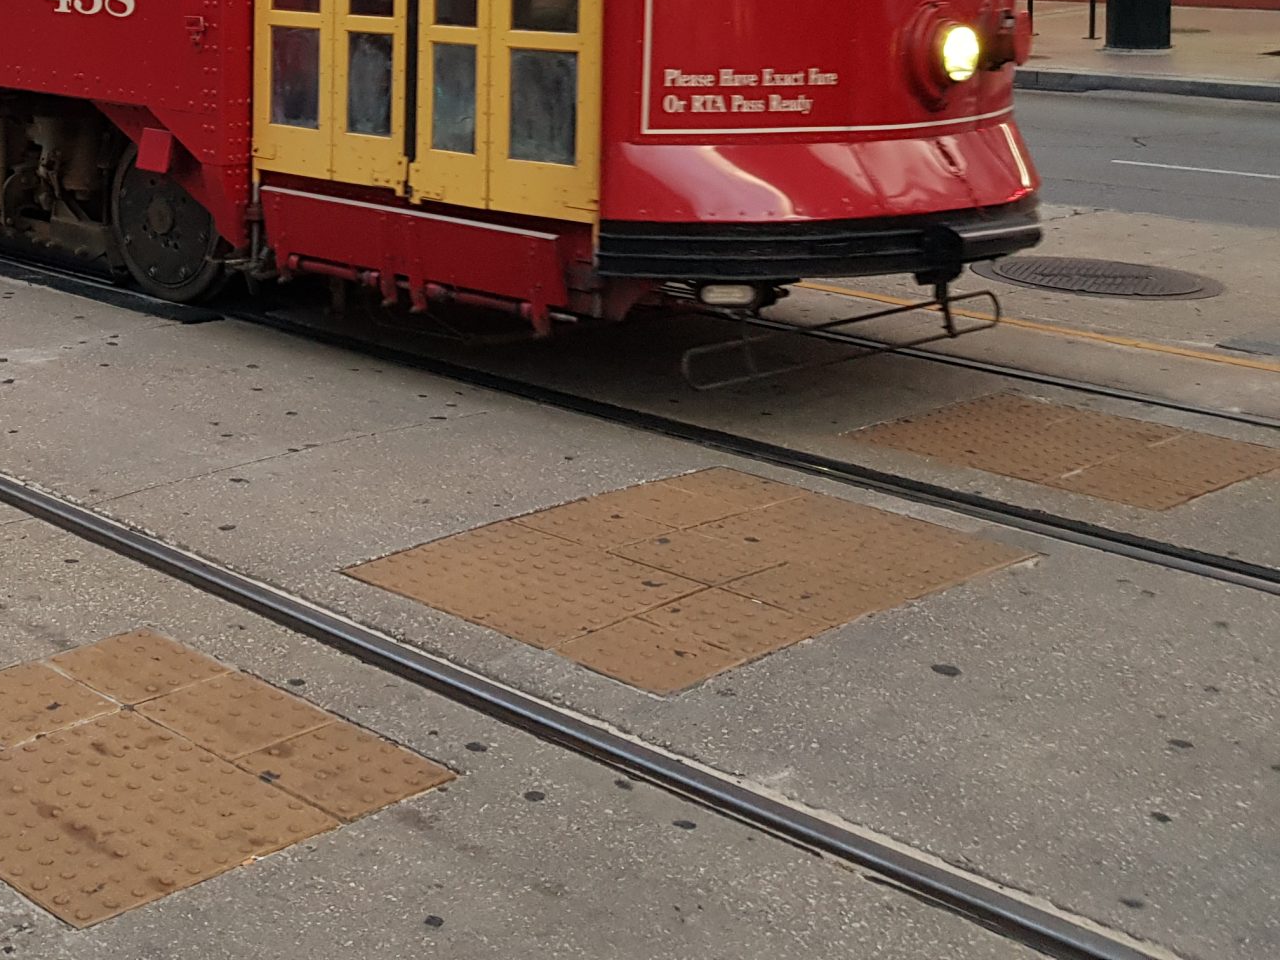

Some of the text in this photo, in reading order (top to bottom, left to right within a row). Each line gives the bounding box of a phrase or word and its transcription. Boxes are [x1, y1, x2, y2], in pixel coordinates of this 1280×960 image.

[664, 68, 716, 87] Please
[718, 68, 759, 87] Have
[761, 68, 806, 87] Exact
[662, 94, 814, 115] Or RTA Pass Ready
